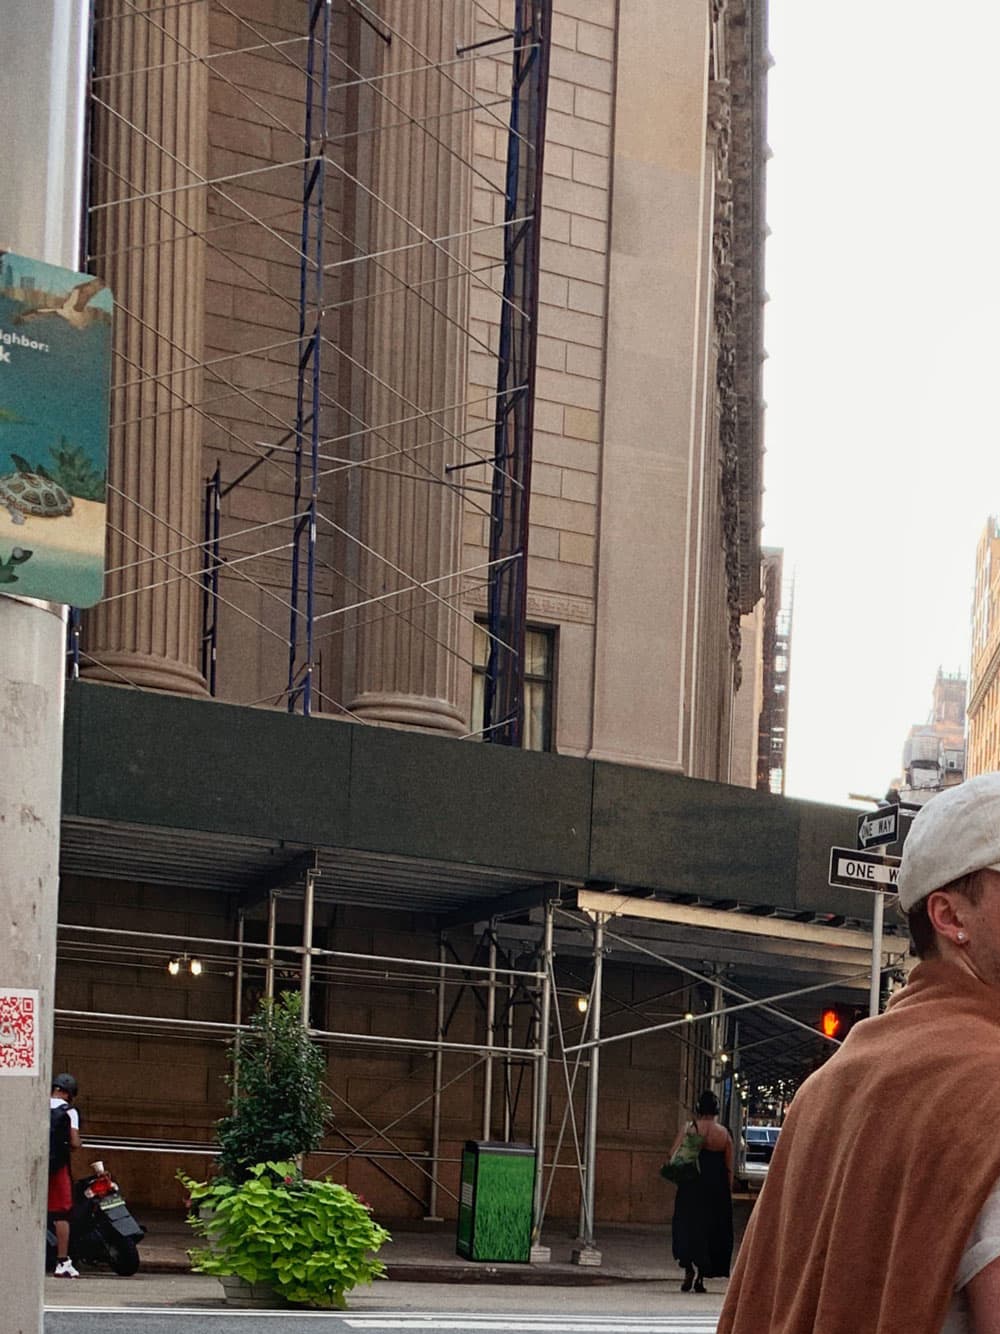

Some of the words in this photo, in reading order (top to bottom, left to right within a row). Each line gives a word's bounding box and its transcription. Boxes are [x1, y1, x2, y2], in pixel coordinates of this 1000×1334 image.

[0, 329, 49, 352] ighbor:
[861, 822, 873, 838] ONE
[878, 818, 893, 835] WAY
[846, 861, 875, 879] ONE
